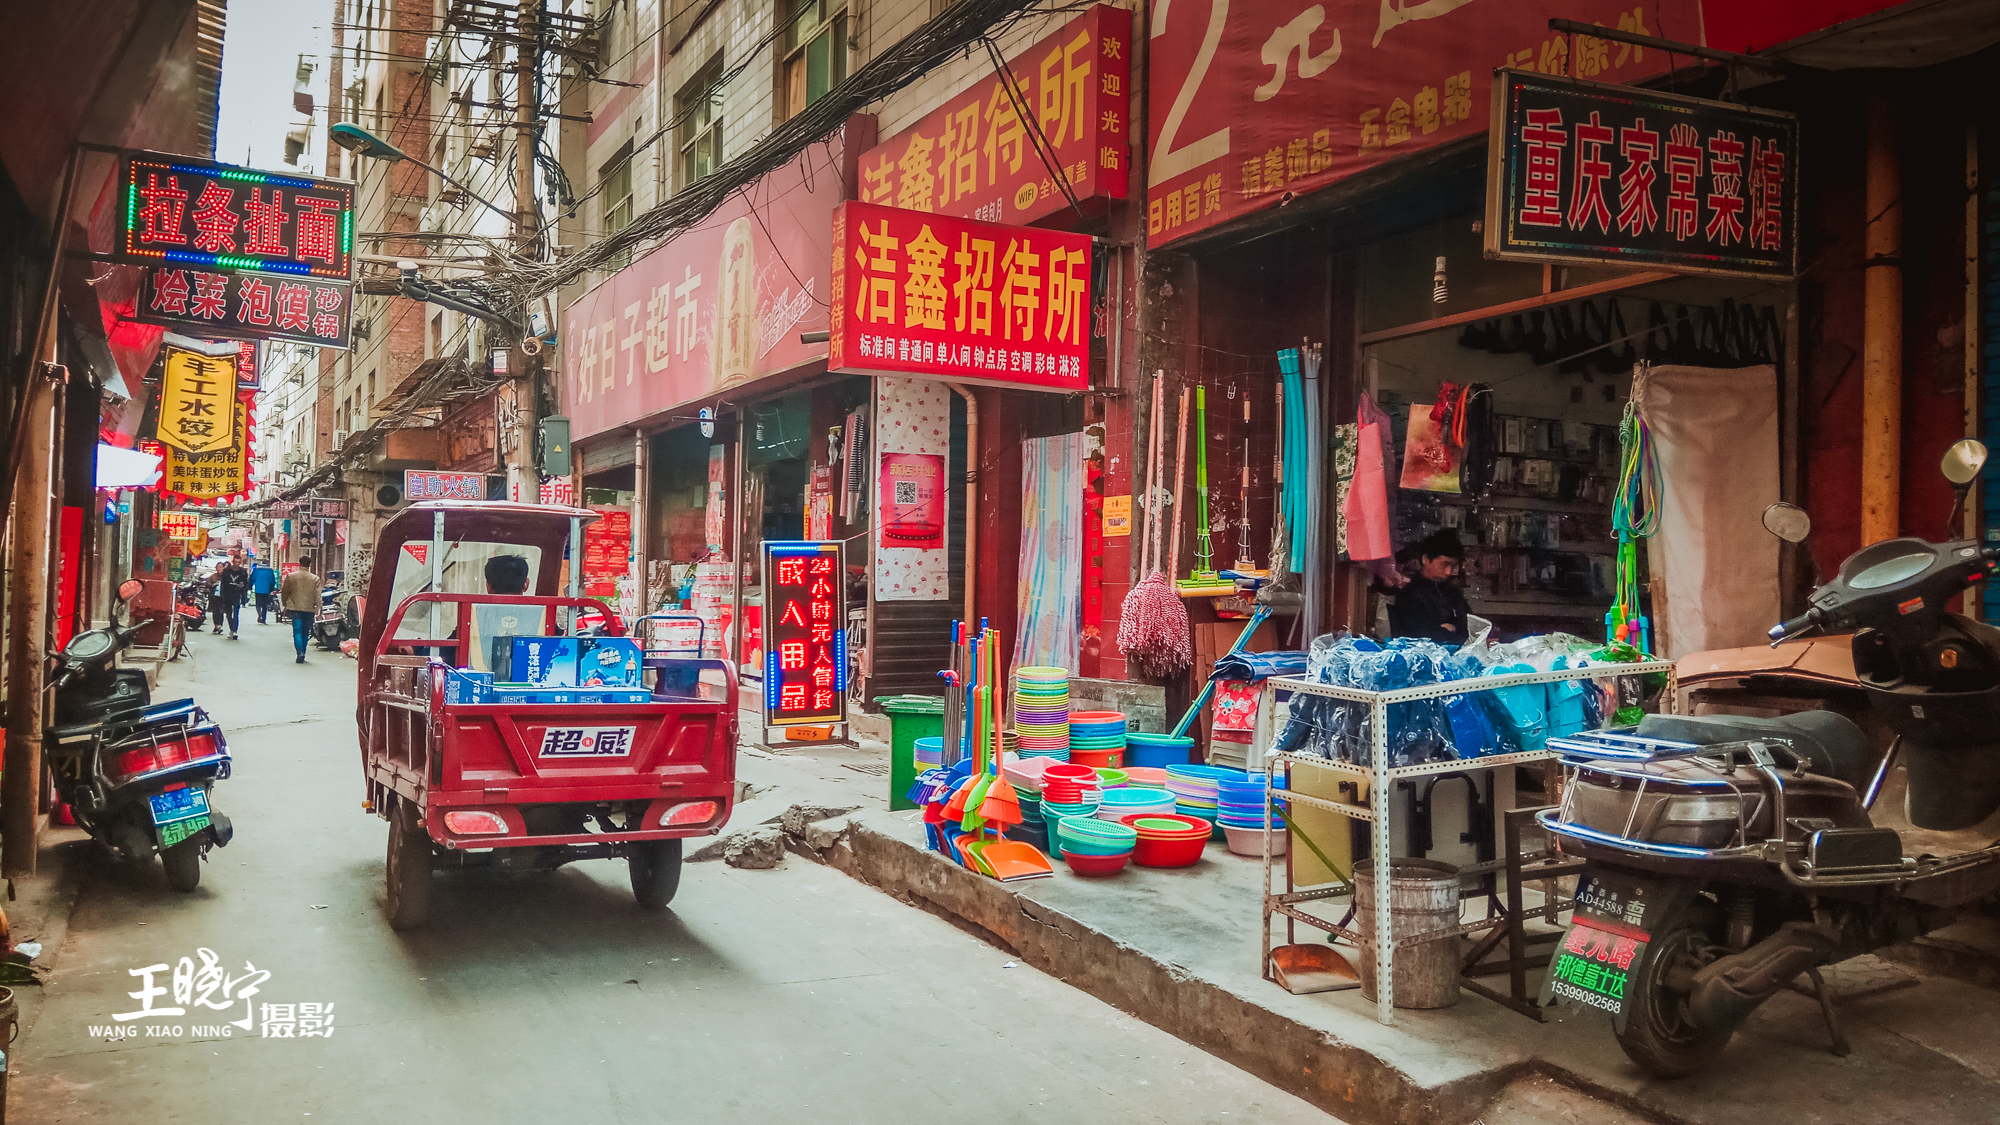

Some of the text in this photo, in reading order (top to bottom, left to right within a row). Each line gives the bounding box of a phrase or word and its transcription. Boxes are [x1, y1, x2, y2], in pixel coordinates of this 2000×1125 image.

[862, 28, 1091, 211] 洁鑫招待所
[1101, 37, 1122, 170] 欢迎光临
[1359, 71, 1472, 156] 五金电器
[1018, 160, 1087, 205] WIFI 全楼覆盖
[1242, 128, 1333, 200] 精美饰品
[1520, 108, 1785, 250] 重庆家常菜馆
[139, 172, 340, 266] 拉条扯面
[1149, 172, 1222, 236] 日用百货
[151, 267, 308, 330] 烩菜 泡馍
[829, 216, 846, 360] 洁鑫招待所
[854, 219, 1086, 346] 洁鑫招待所
[312, 286, 342, 340] 砂锅
[578, 263, 702, 405] 好日子超市
[859, 333, 1080, 377] 标准间 普通间 单人间 钟点房 空调 彩电 淋浴
[177, 356, 217, 440] 手工水饺
[172, 481, 239, 493] 麻辣米线
[173, 452, 239, 464] 特炒河粉
[173, 466, 239, 478] 美味蛋炒饭
[409, 474, 480, 498] 自助火锅
[889, 463, 936, 478] 新店开业
[779, 558, 806, 709] 成人用品
[541, 729, 629, 756] 超威
[1576, 891, 1623, 915] AD44588
[1553, 953, 1628, 999] 邦德富士达
[1564, 924, 1639, 970] 经九路
[1550, 980, 1622, 1014] 15399082568
